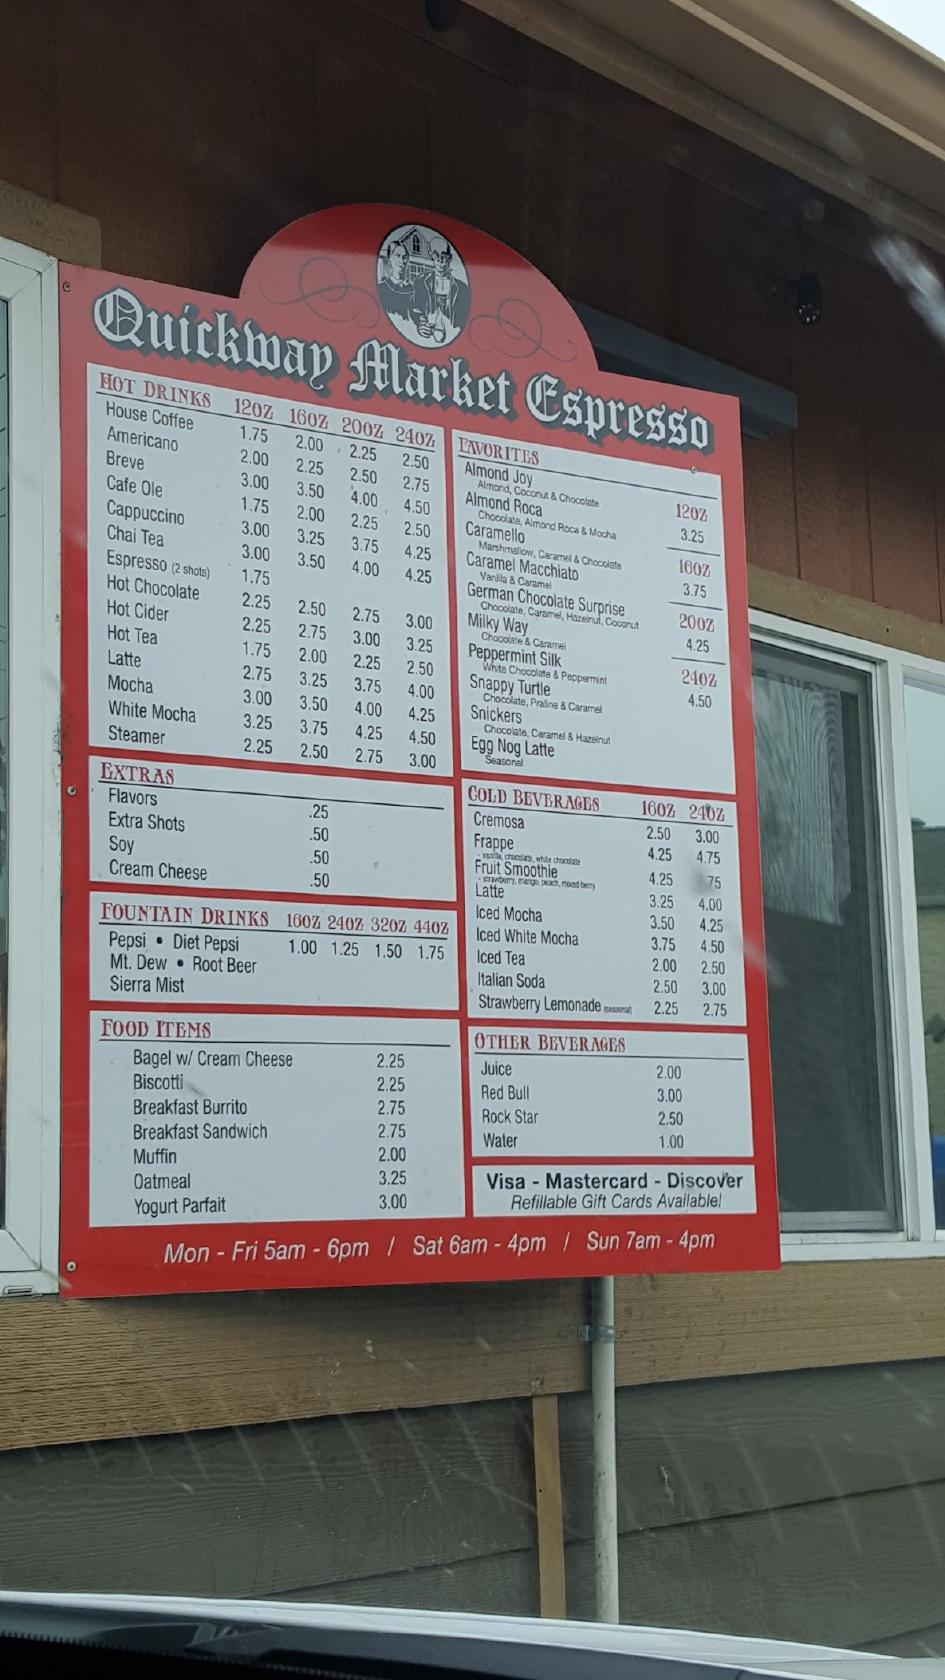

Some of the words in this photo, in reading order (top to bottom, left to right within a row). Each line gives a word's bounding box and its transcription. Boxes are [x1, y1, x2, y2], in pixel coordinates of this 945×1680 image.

[93, 288, 332, 390] Quickway
[349, 339, 511, 414] Market
[526, 374, 709, 450] Espresso
[99, 371, 136, 395] HOT
[142, 380, 211, 408] DRINKS
[106, 400, 148, 422] House
[151, 408, 194, 431] Coffee
[240, 424, 268, 444] 1.75
[295, 434, 324, 452] 2.00
[349, 443, 377, 462] 2.25
[402, 452, 430, 470] 2.50
[457, 436, 539, 466] FAVORITES
[464, 461, 509, 482] Almond
[512, 469, 533, 489] Joy
[106, 474, 137, 494] Cafe
[141, 479, 163, 498] Ole
[241, 496, 269, 514] 1.75
[297, 505, 325, 523] 2.00
[351, 512, 378, 531] 2.25
[404, 521, 431, 538] 2.50
[477, 480, 512, 495] Almond,
[513, 486, 549, 500] Coconut
[558, 493, 600, 508] Chocolate
[680, 527, 704, 544] 3.25
[106, 549, 168, 572] Espresso
[171, 562, 181, 575] (2
[183, 564, 210, 580] shots)
[242, 568, 270, 586] 1.75
[466, 550, 516, 572] Caramel
[519, 558, 579, 581] Macchiato
[107, 573, 131, 592] Hot
[134, 577, 200, 601] Chocolate
[242, 591, 271, 610] 2.25
[298, 599, 326, 617] 2.50
[352, 606, 380, 624] 2.75
[405, 613, 433, 630] 3.00
[467, 581, 514, 602] German
[517, 588, 575, 611] Chocolate
[578, 596, 625, 620] Surprise
[468, 642, 537, 667] Peppermint
[539, 650, 562, 668] Silk
[686, 638, 710, 653] 4.25
[482, 661, 507, 674] White
[508, 665, 551, 679] Chocolate
[561, 671, 607, 685] Peppermint
[470, 704, 523, 724] Snickers
[108, 724, 166, 745] Steamer
[243, 737, 273, 755] 2.25
[300, 742, 329, 760] 2.50
[355, 747, 383, 765] 2.75
[409, 752, 437, 769] 3.00
[471, 735, 494, 756] Egg
[497, 737, 521, 758] Nog
[524, 739, 555, 758] Latte
[100, 761, 175, 785] EXTRAS
[485, 755, 524, 767] Seasonal
[108, 787, 158, 807] Flavors
[308, 803, 329, 820] .25
[467, 784, 507, 804] COLD
[512, 788, 600, 812] BEVERAGES
[108, 810, 144, 829] Extra
[147, 813, 186, 832] Shots
[309, 826, 329, 842] .50
[473, 810, 525, 830] Cremosa
[646, 825, 671, 841] 2.50
[695, 829, 720, 845] 3.00
[109, 835, 135, 856] Soy
[310, 849, 330, 865] .50
[109, 858, 154, 878] Cream
[158, 862, 208, 881] Cheese
[310, 872, 330, 888] .50
[100, 902, 193, 924] FOUNTAIN
[200, 906, 269, 927] DRINKS
[109, 930, 146, 952] Pepsi
[173, 932, 200, 950] Diet
[204, 934, 239, 958] Pepsi
[288, 938, 317, 955] 1.00
[331, 940, 359, 957] 1.25
[375, 943, 403, 959] 1.50
[418, 944, 445, 961] 1.75
[476, 926, 501, 943] Iced
[504, 928, 537, 945] White
[540, 929, 579, 946] Mocha
[651, 936, 676, 952] 3.75
[700, 939, 725, 954] 4.50
[110, 952, 132, 970] Mt.
[137, 953, 168, 971] Dew
[192, 955, 224, 973] Root
[227, 956, 257, 974] Beer
[110, 974, 151, 993] Sierra
[155, 976, 185, 993] Mist
[478, 993, 541, 1014] Strawberry
[543, 995, 602, 1013] Lemonade
[654, 1000, 679, 1016] 2.25
[703, 1002, 727, 1017] 2.75
[100, 1018, 149, 1037] FOOD
[155, 1019, 211, 1039] ITEMS
[474, 1032, 532, 1051] OTHER
[537, 1033, 626, 1053] BEVERAGES
[133, 1048, 172, 1069] Bagel
[176, 1049, 194, 1066] w/
[197, 1050, 241, 1067] Cream
[245, 1050, 293, 1067] Cheese
[376, 1052, 405, 1069] 2.25
[133, 1098, 199, 1116] Breakfast
[203, 1098, 247, 1115] Burrito
[377, 1099, 406, 1116] 2.75
[481, 1084, 504, 1100] Red
[507, 1084, 530, 1100] Bull
[657, 1087, 683, 1103] 3.00
[486, 1172, 526, 1190] Visa
[545, 1171, 648, 1190] Mastercard
[667, 1171, 744, 1190] Discover
[134, 1197, 179, 1218] Yogurt
[182, 1196, 226, 1214] Parfait
[379, 1193, 407, 1210] 3.00
[510, 1193, 577, 1210] Refillable
[581, 1193, 607, 1209] Gift
[611, 1192, 653, 1209] Cards
[656, 1192, 722, 1209] Available!
[164, 1243, 210, 1264] Mon
[232, 1240, 258, 1261] Fri
[264, 1239, 306, 1261] 5am
[327, 1237, 370, 1263] 6pm
[413, 1235, 443, 1256] Sat
[449, 1234, 488, 1254] 6am
[507, 1232, 547, 1257] 4pm
[586, 1231, 620, 1251] Sun
[626, 1231, 661, 1250] 7am
[679, 1230, 715, 1254] 4pm
